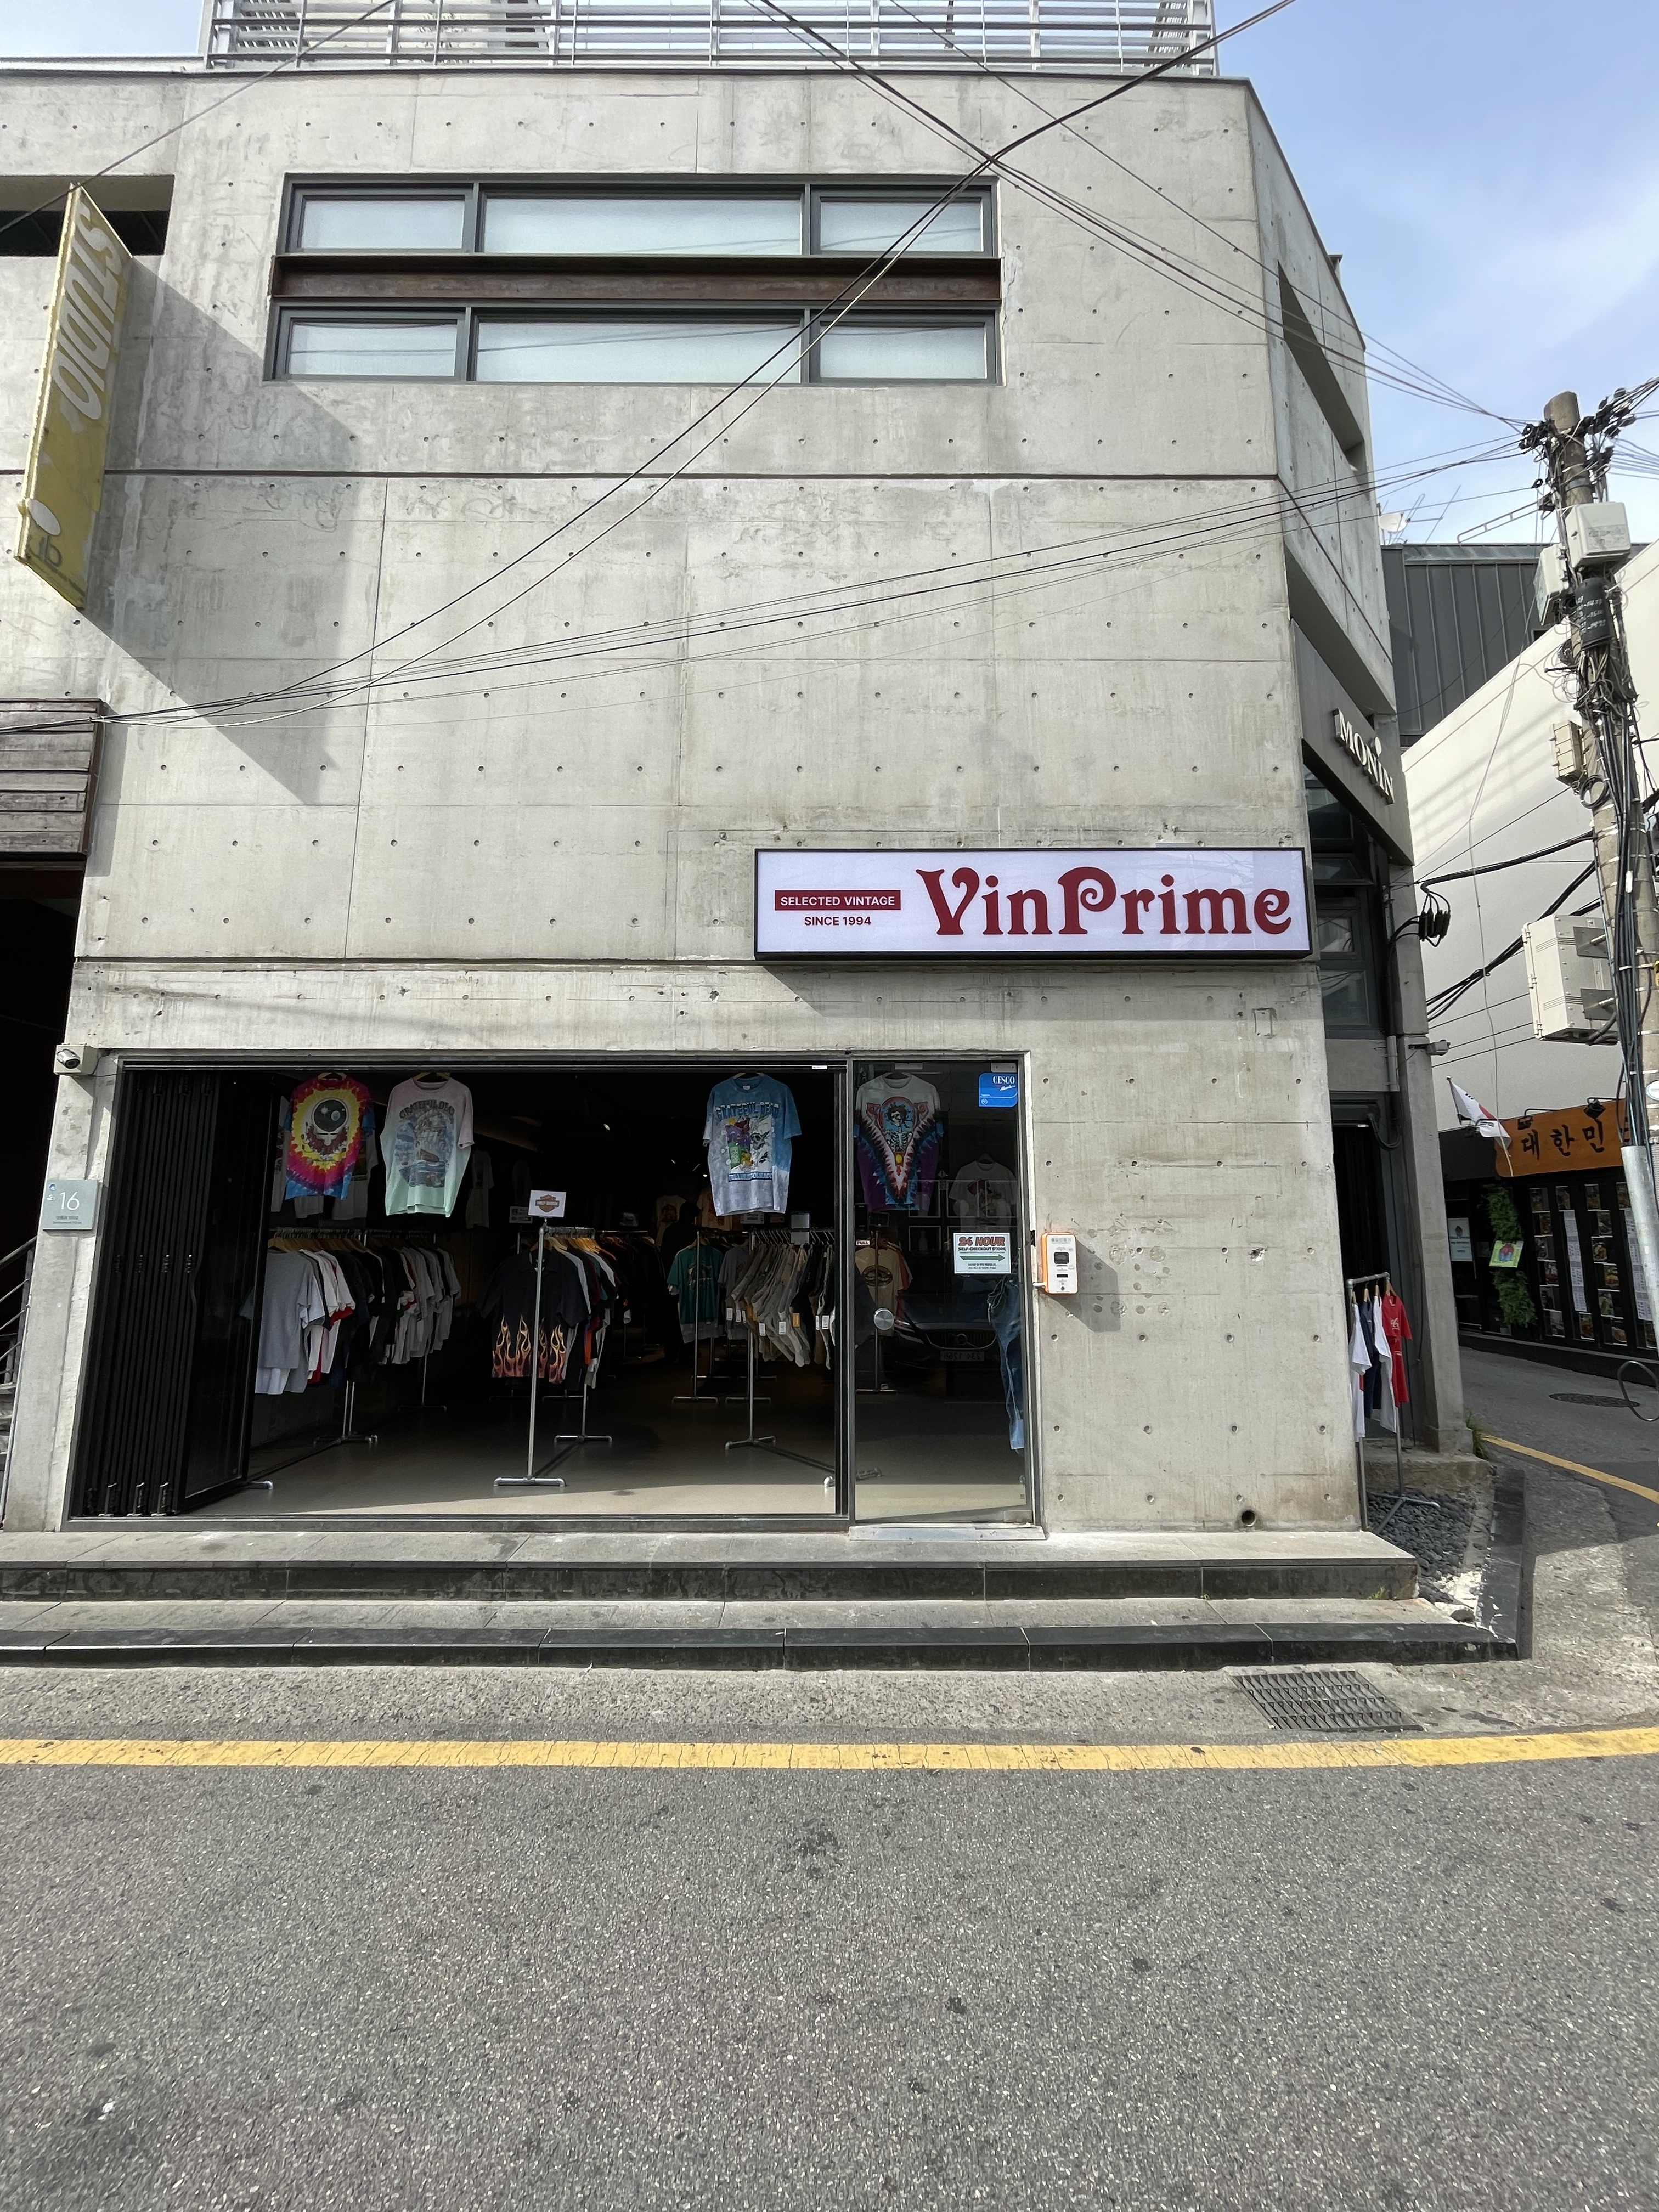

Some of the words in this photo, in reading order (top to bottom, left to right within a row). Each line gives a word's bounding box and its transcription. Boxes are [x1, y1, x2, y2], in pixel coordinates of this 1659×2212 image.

[53, 201, 122, 420] STUDIO
[780, 896, 841, 906] SELECTED
[844, 896, 895, 906] VINTAGE
[916, 867, 1291, 934] VinPrime
[804, 916, 839, 926] SINCE
[842, 916, 871, 926] 1994
[992, 1076, 1015, 1084] CESCO
[1520, 1118, 1629, 1160] 대한민
[59, 1192, 80, 1210] 16
[975, 1236, 1006, 1246] HOUR
